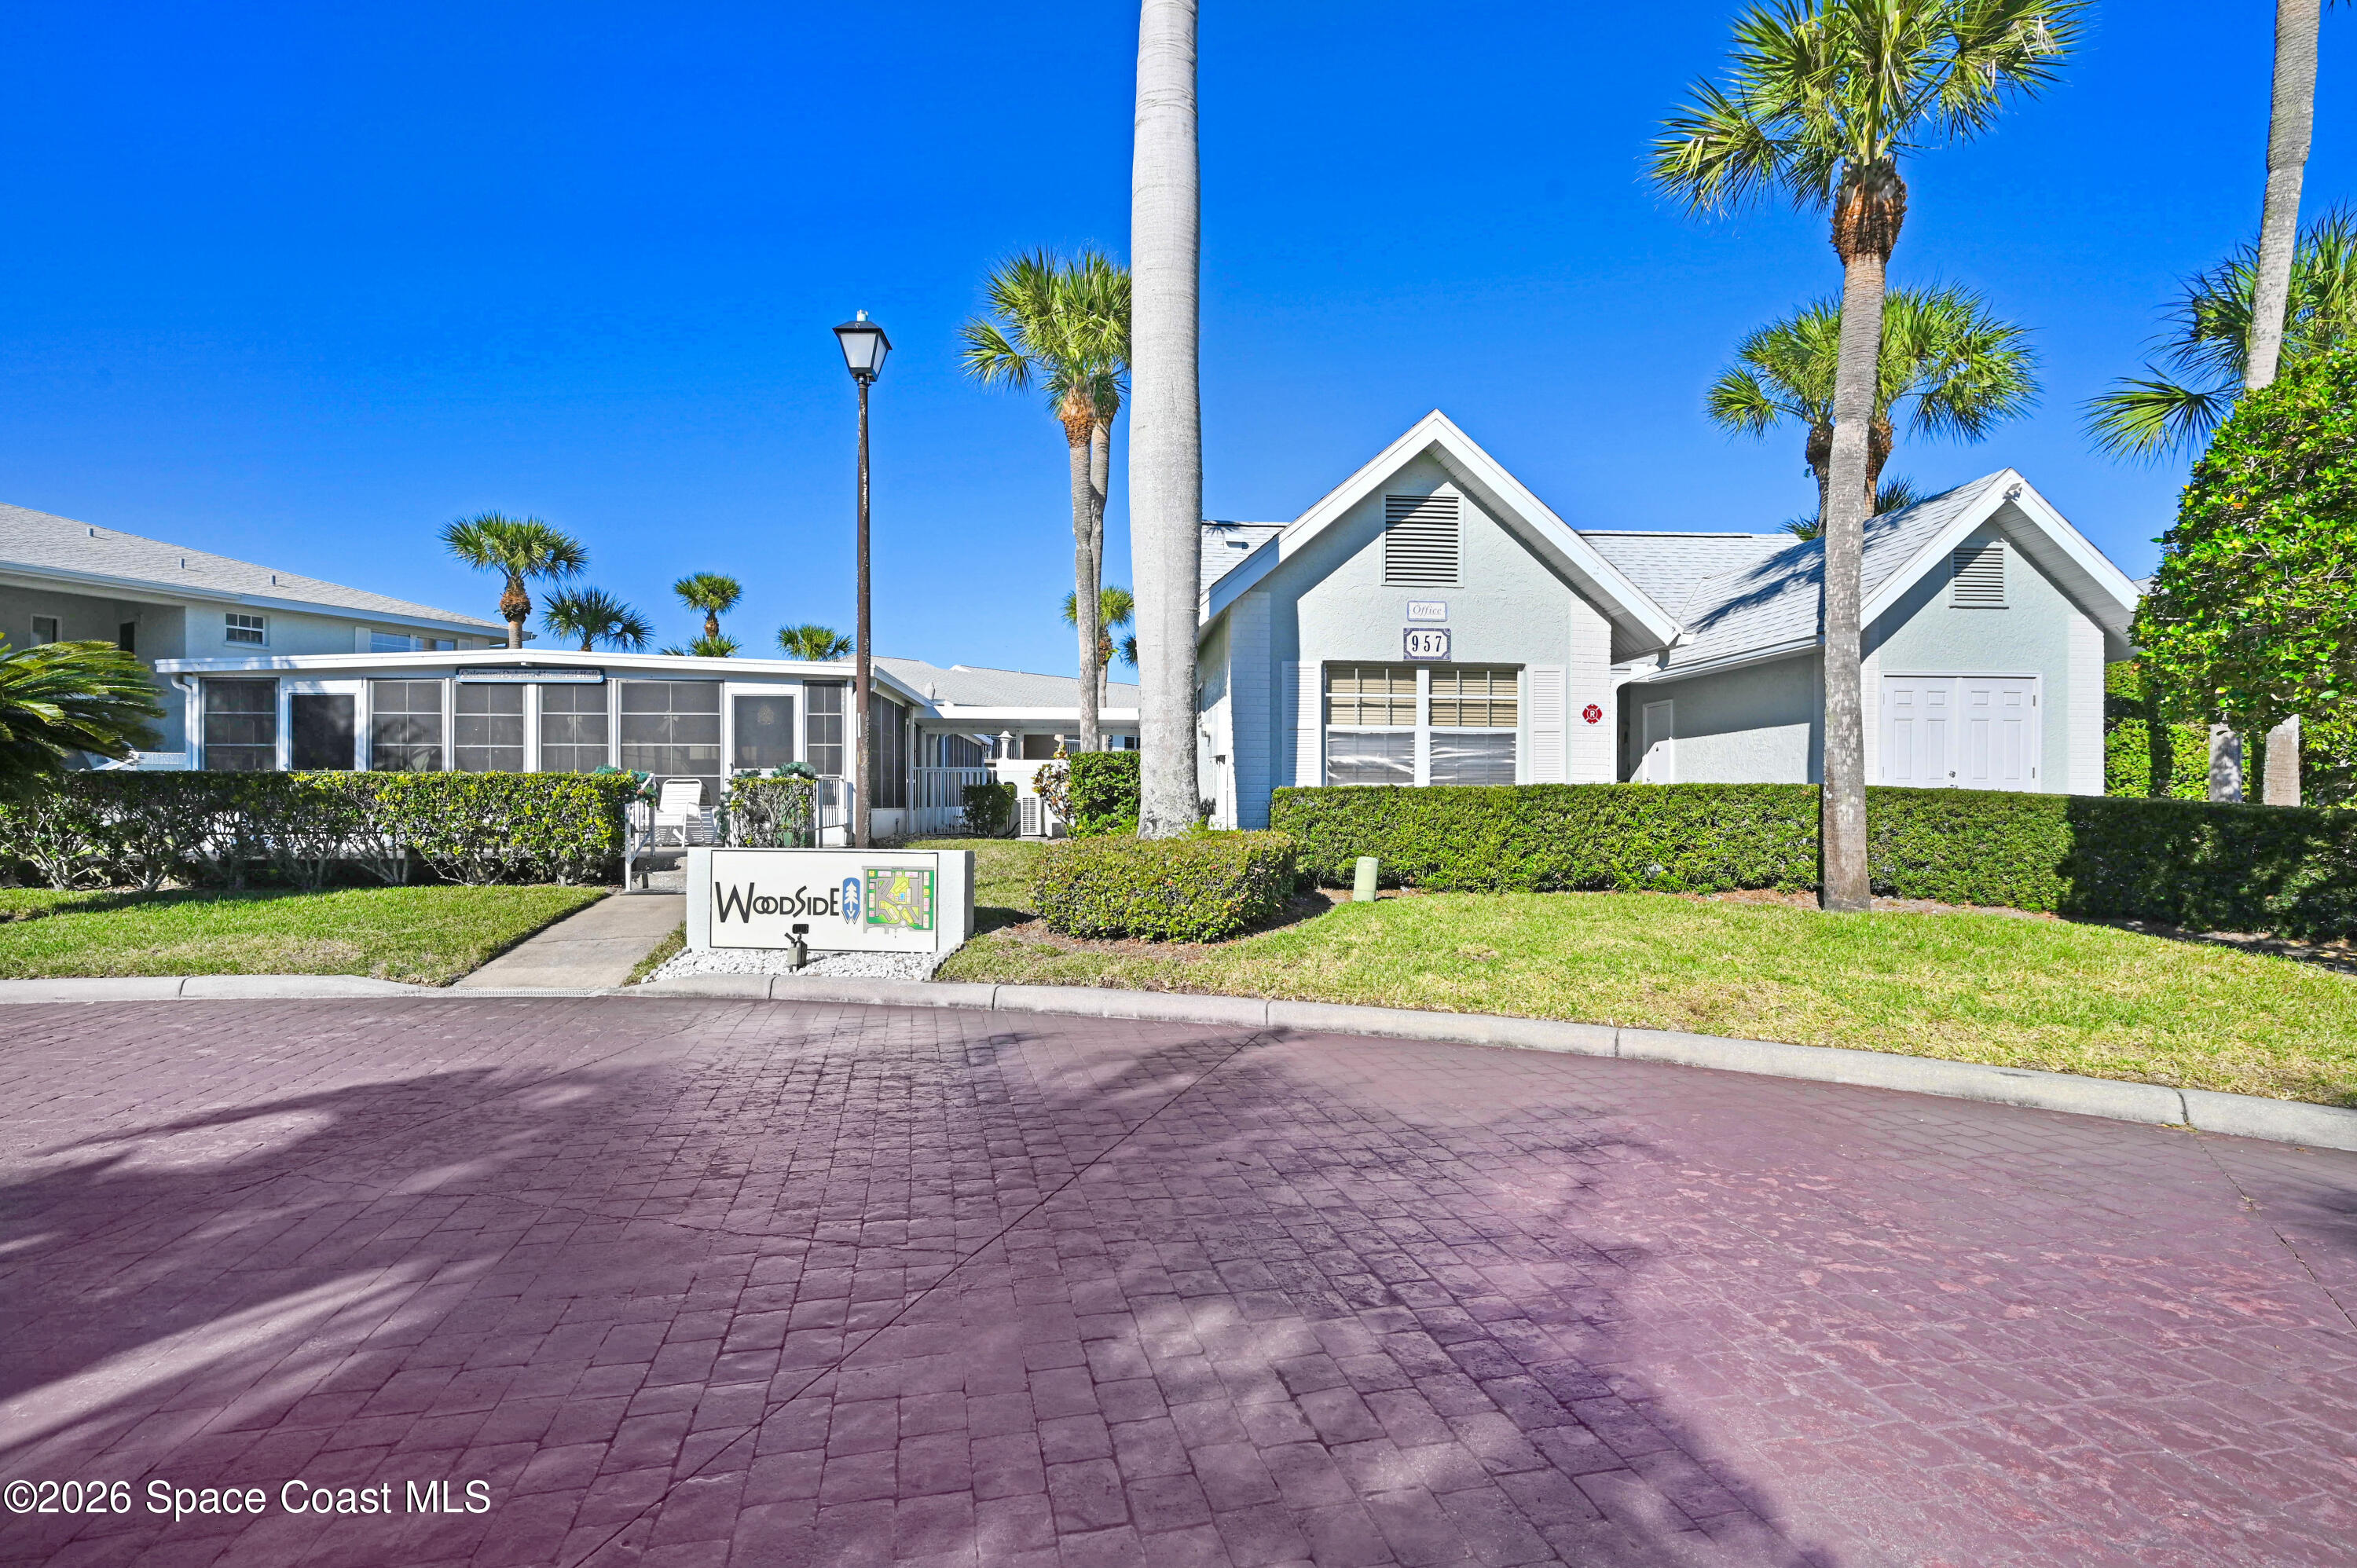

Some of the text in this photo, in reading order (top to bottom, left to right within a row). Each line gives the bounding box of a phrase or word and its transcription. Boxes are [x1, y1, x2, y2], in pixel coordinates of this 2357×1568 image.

[1413, 604, 1442, 617] Office
[1412, 635, 1442, 652] 957
[579, 670, 599, 680] Hall
